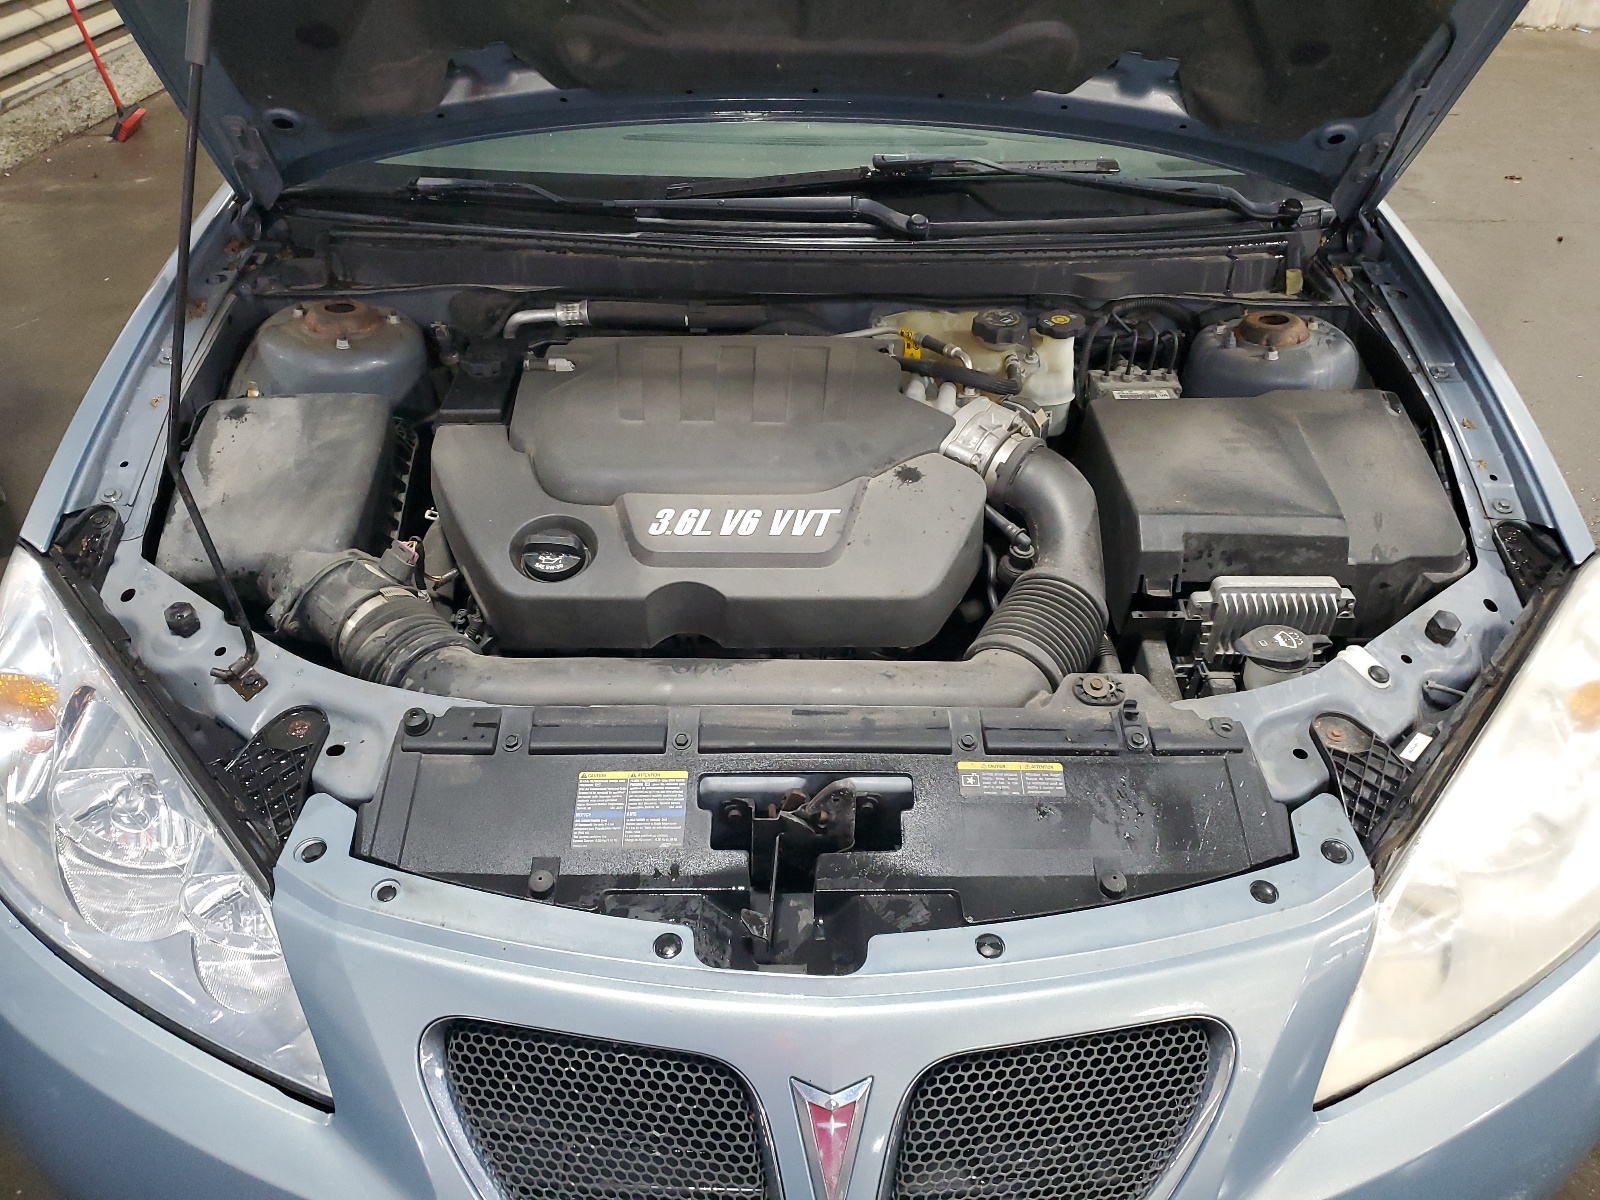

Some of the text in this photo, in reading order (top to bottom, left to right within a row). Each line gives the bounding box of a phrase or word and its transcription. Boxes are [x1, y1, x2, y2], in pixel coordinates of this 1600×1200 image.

[648, 508, 842, 537] 3.6L V6 VVT
